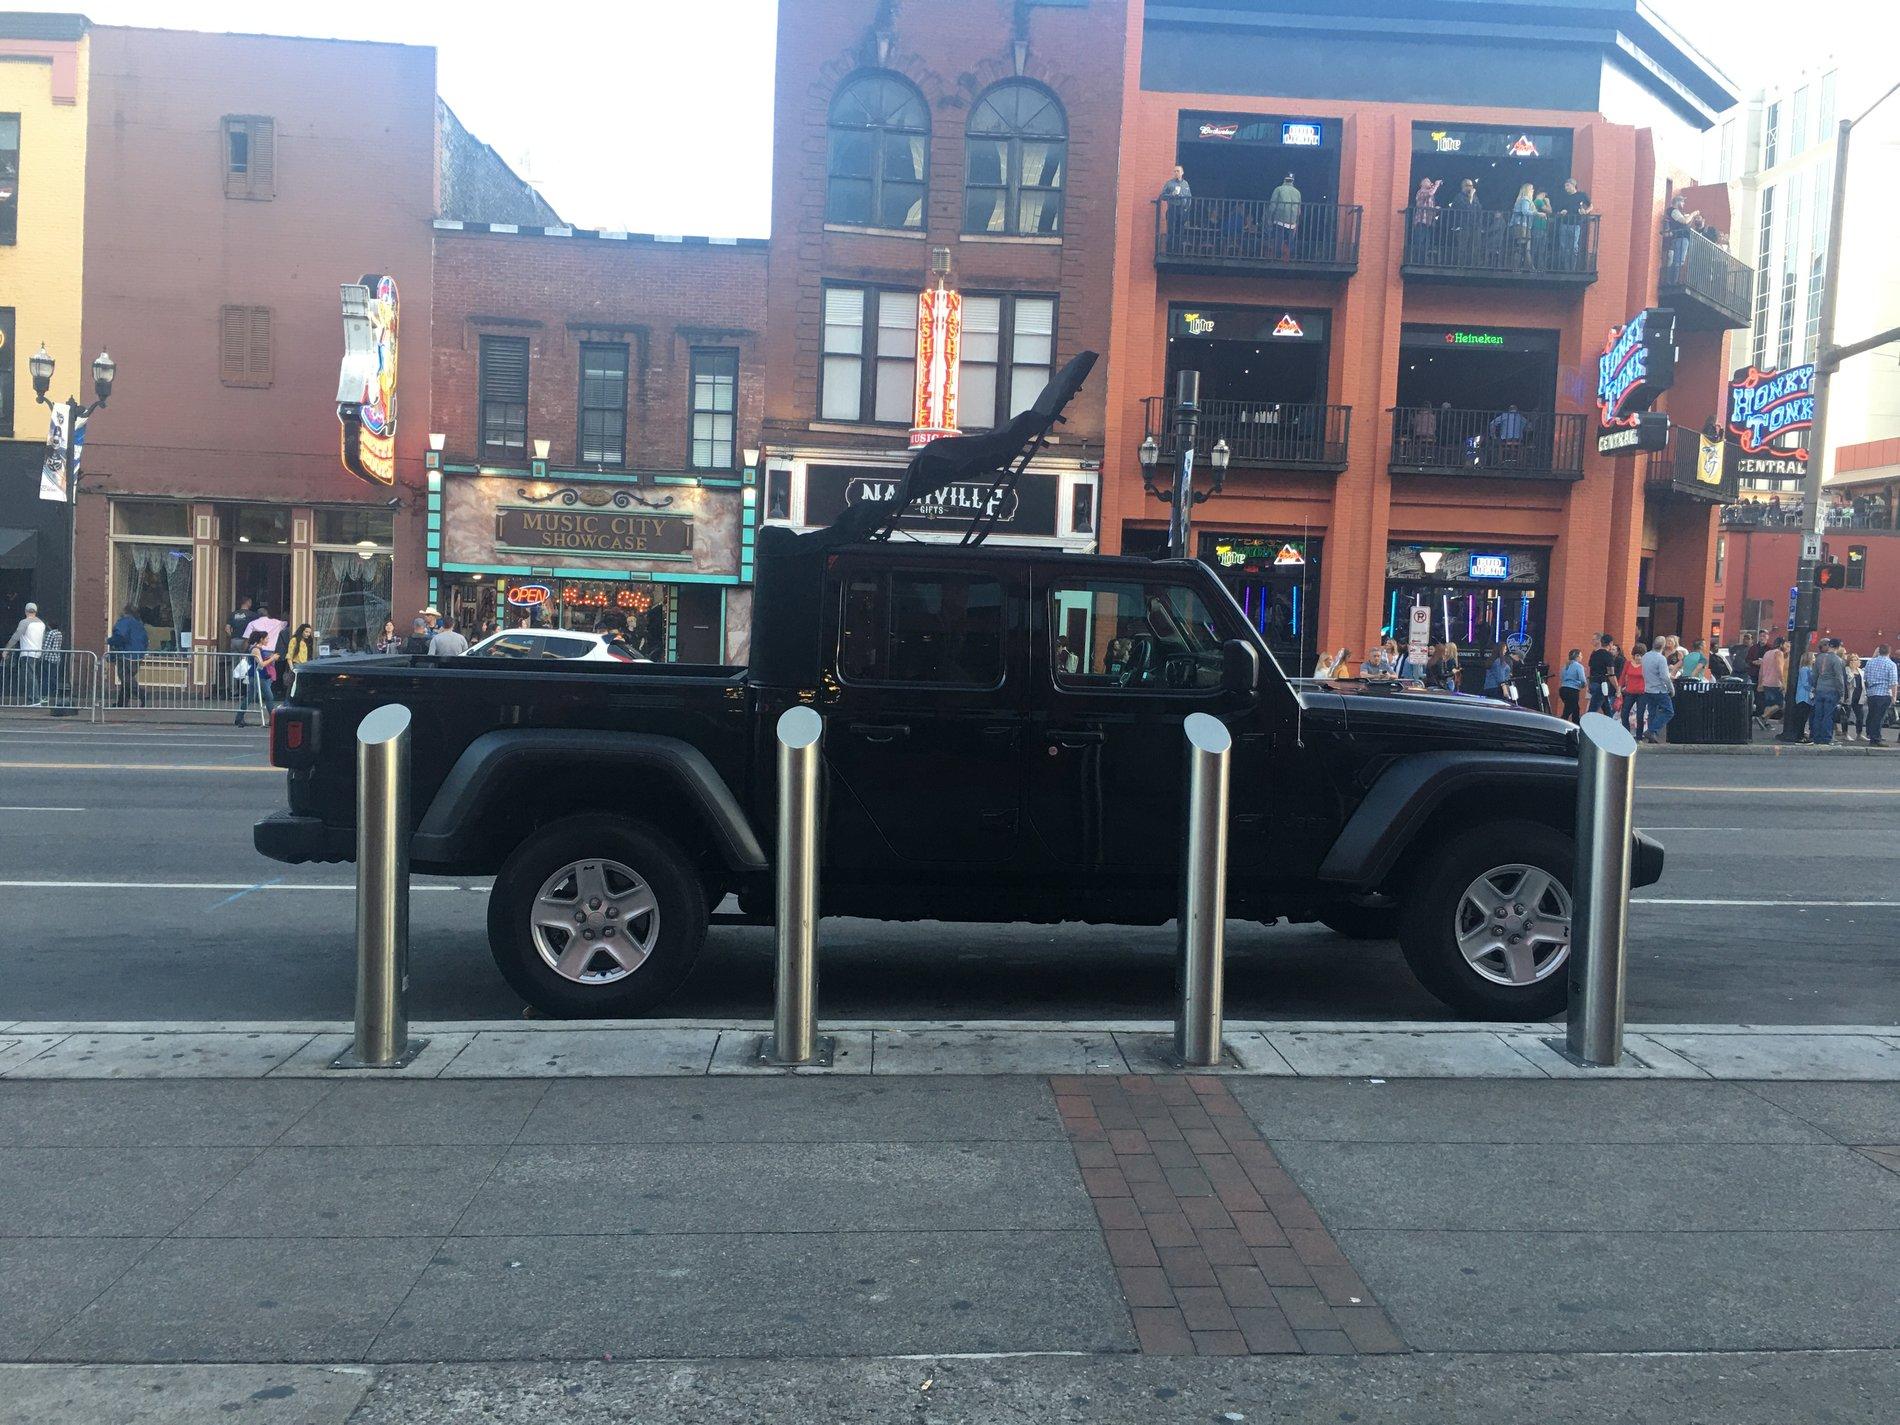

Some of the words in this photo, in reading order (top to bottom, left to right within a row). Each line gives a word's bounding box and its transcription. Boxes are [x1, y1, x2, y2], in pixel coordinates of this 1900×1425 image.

[1189, 317, 1215, 334] Lite
[1454, 332, 1504, 344] Heineken
[1731, 366, 1813, 422] HONKY
[1746, 397, 1815, 448] TONK
[1598, 428, 1639, 452] CENTRAL
[1737, 459, 1807, 475] CENTRAL
[861, 483, 1004, 518] NAVILLE
[919, 506, 944, 515] GIFTS
[522, 511, 600, 533] MUSIC
[611, 517, 668, 537] CITY
[541, 532, 648, 551] SHOWCASE
[509, 587, 547, 603] OPEN
